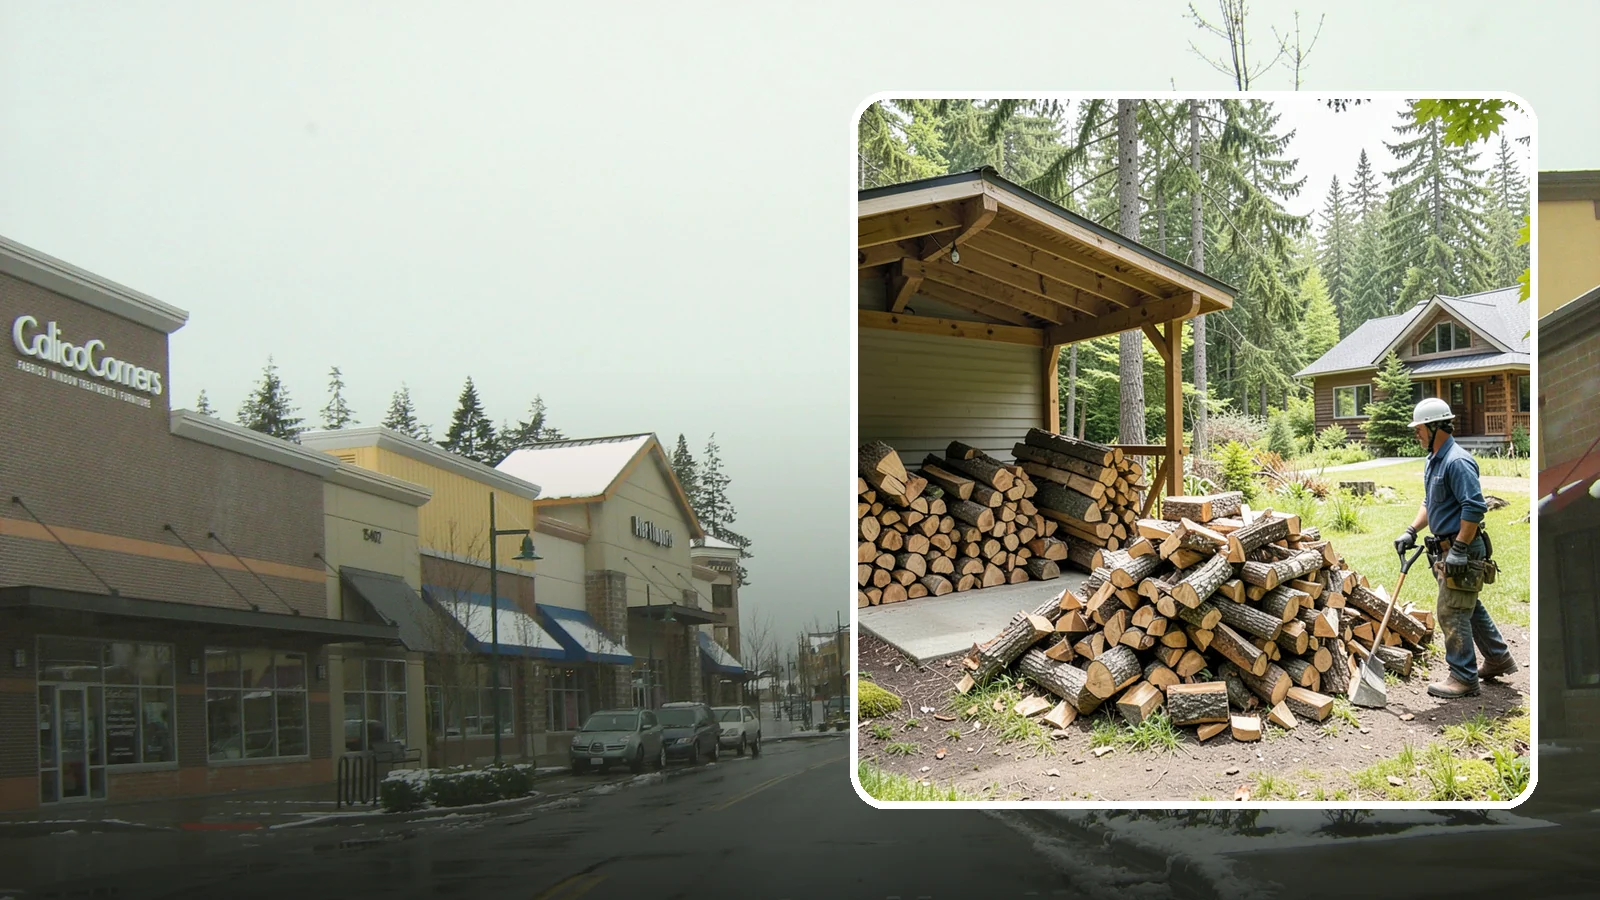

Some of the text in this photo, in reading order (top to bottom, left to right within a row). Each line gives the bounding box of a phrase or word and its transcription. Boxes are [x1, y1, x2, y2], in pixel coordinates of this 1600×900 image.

[17, 360, 47, 377] FABRICS
[51, 370, 78, 386] WINDOW
[79, 379, 116, 398] TREATMENTS
